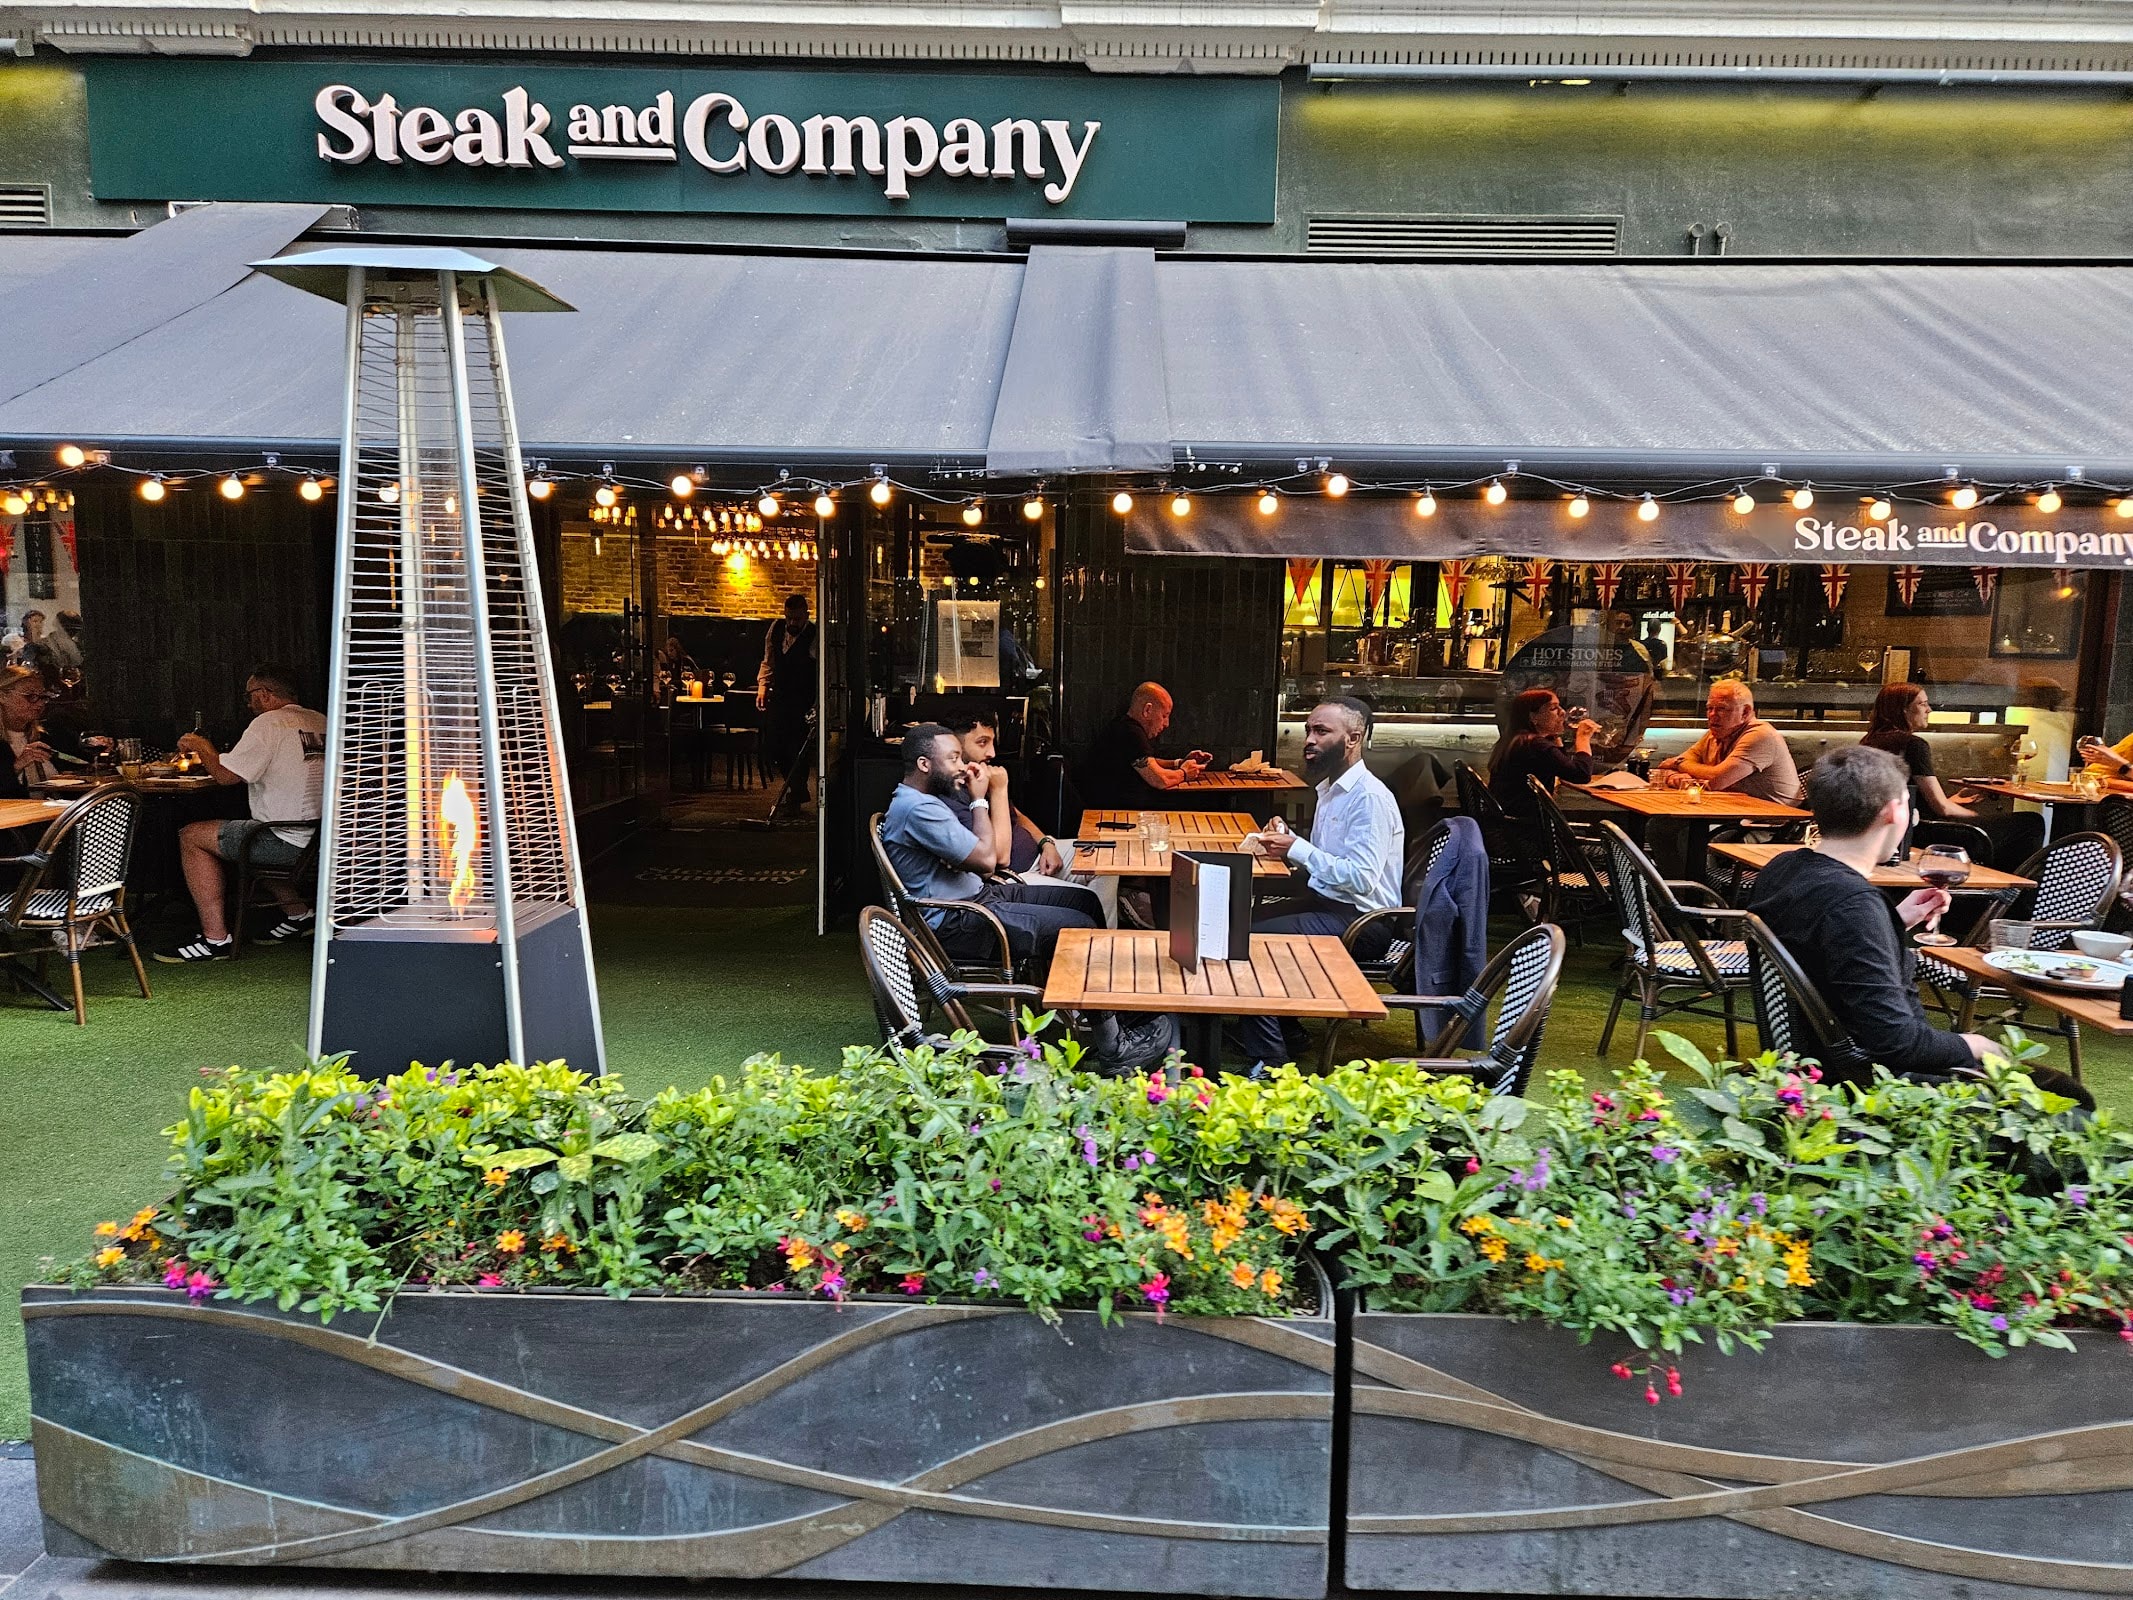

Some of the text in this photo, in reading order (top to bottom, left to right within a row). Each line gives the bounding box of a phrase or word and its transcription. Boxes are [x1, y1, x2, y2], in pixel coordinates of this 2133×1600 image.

[314, 84, 1101, 204] Steak and Company
[1794, 517, 1915, 552] Steak
[1917, 521, 1967, 545] and
[1533, 647, 1623, 661] HOT STONES
